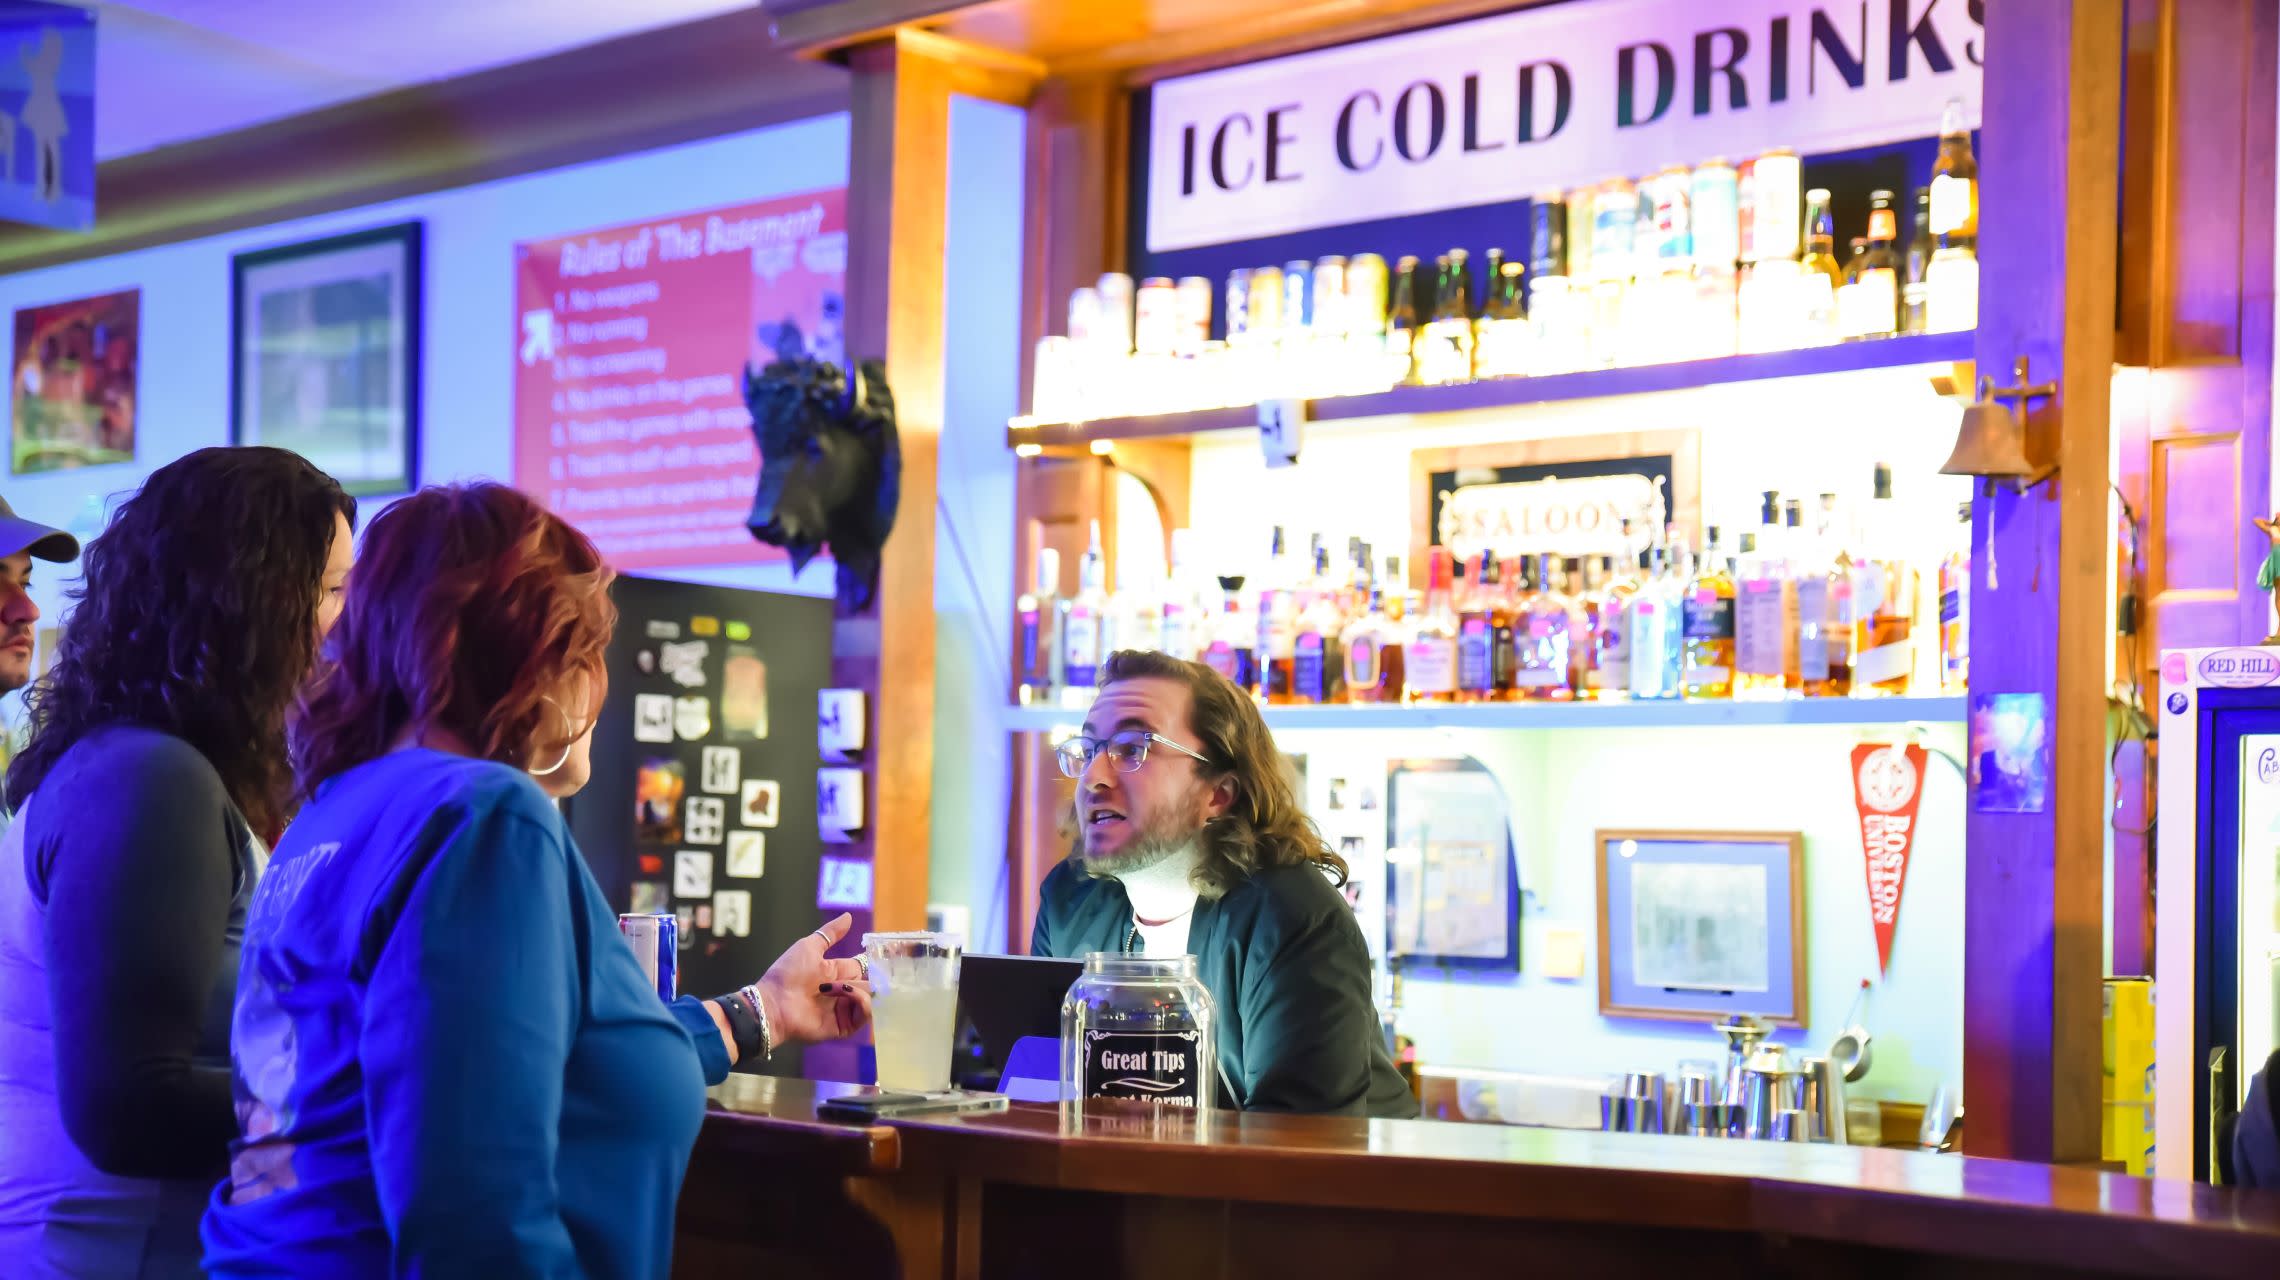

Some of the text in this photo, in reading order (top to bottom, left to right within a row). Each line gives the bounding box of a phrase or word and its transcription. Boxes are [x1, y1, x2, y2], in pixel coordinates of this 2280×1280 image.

[1181, 102, 1302, 195] ICE
[1335, 59, 1572, 172] COLD
[560, 237, 621, 277] Rules
[622, 227, 651, 269] of
[655, 222, 701, 261] The
[704, 201, 824, 255] Basement
[569, 288, 594, 311] No
[2207, 658, 2275, 673] RED HILL
[1881, 814, 1911, 924] BOSTON
[1101, 1051, 1185, 1073] Great Tips
